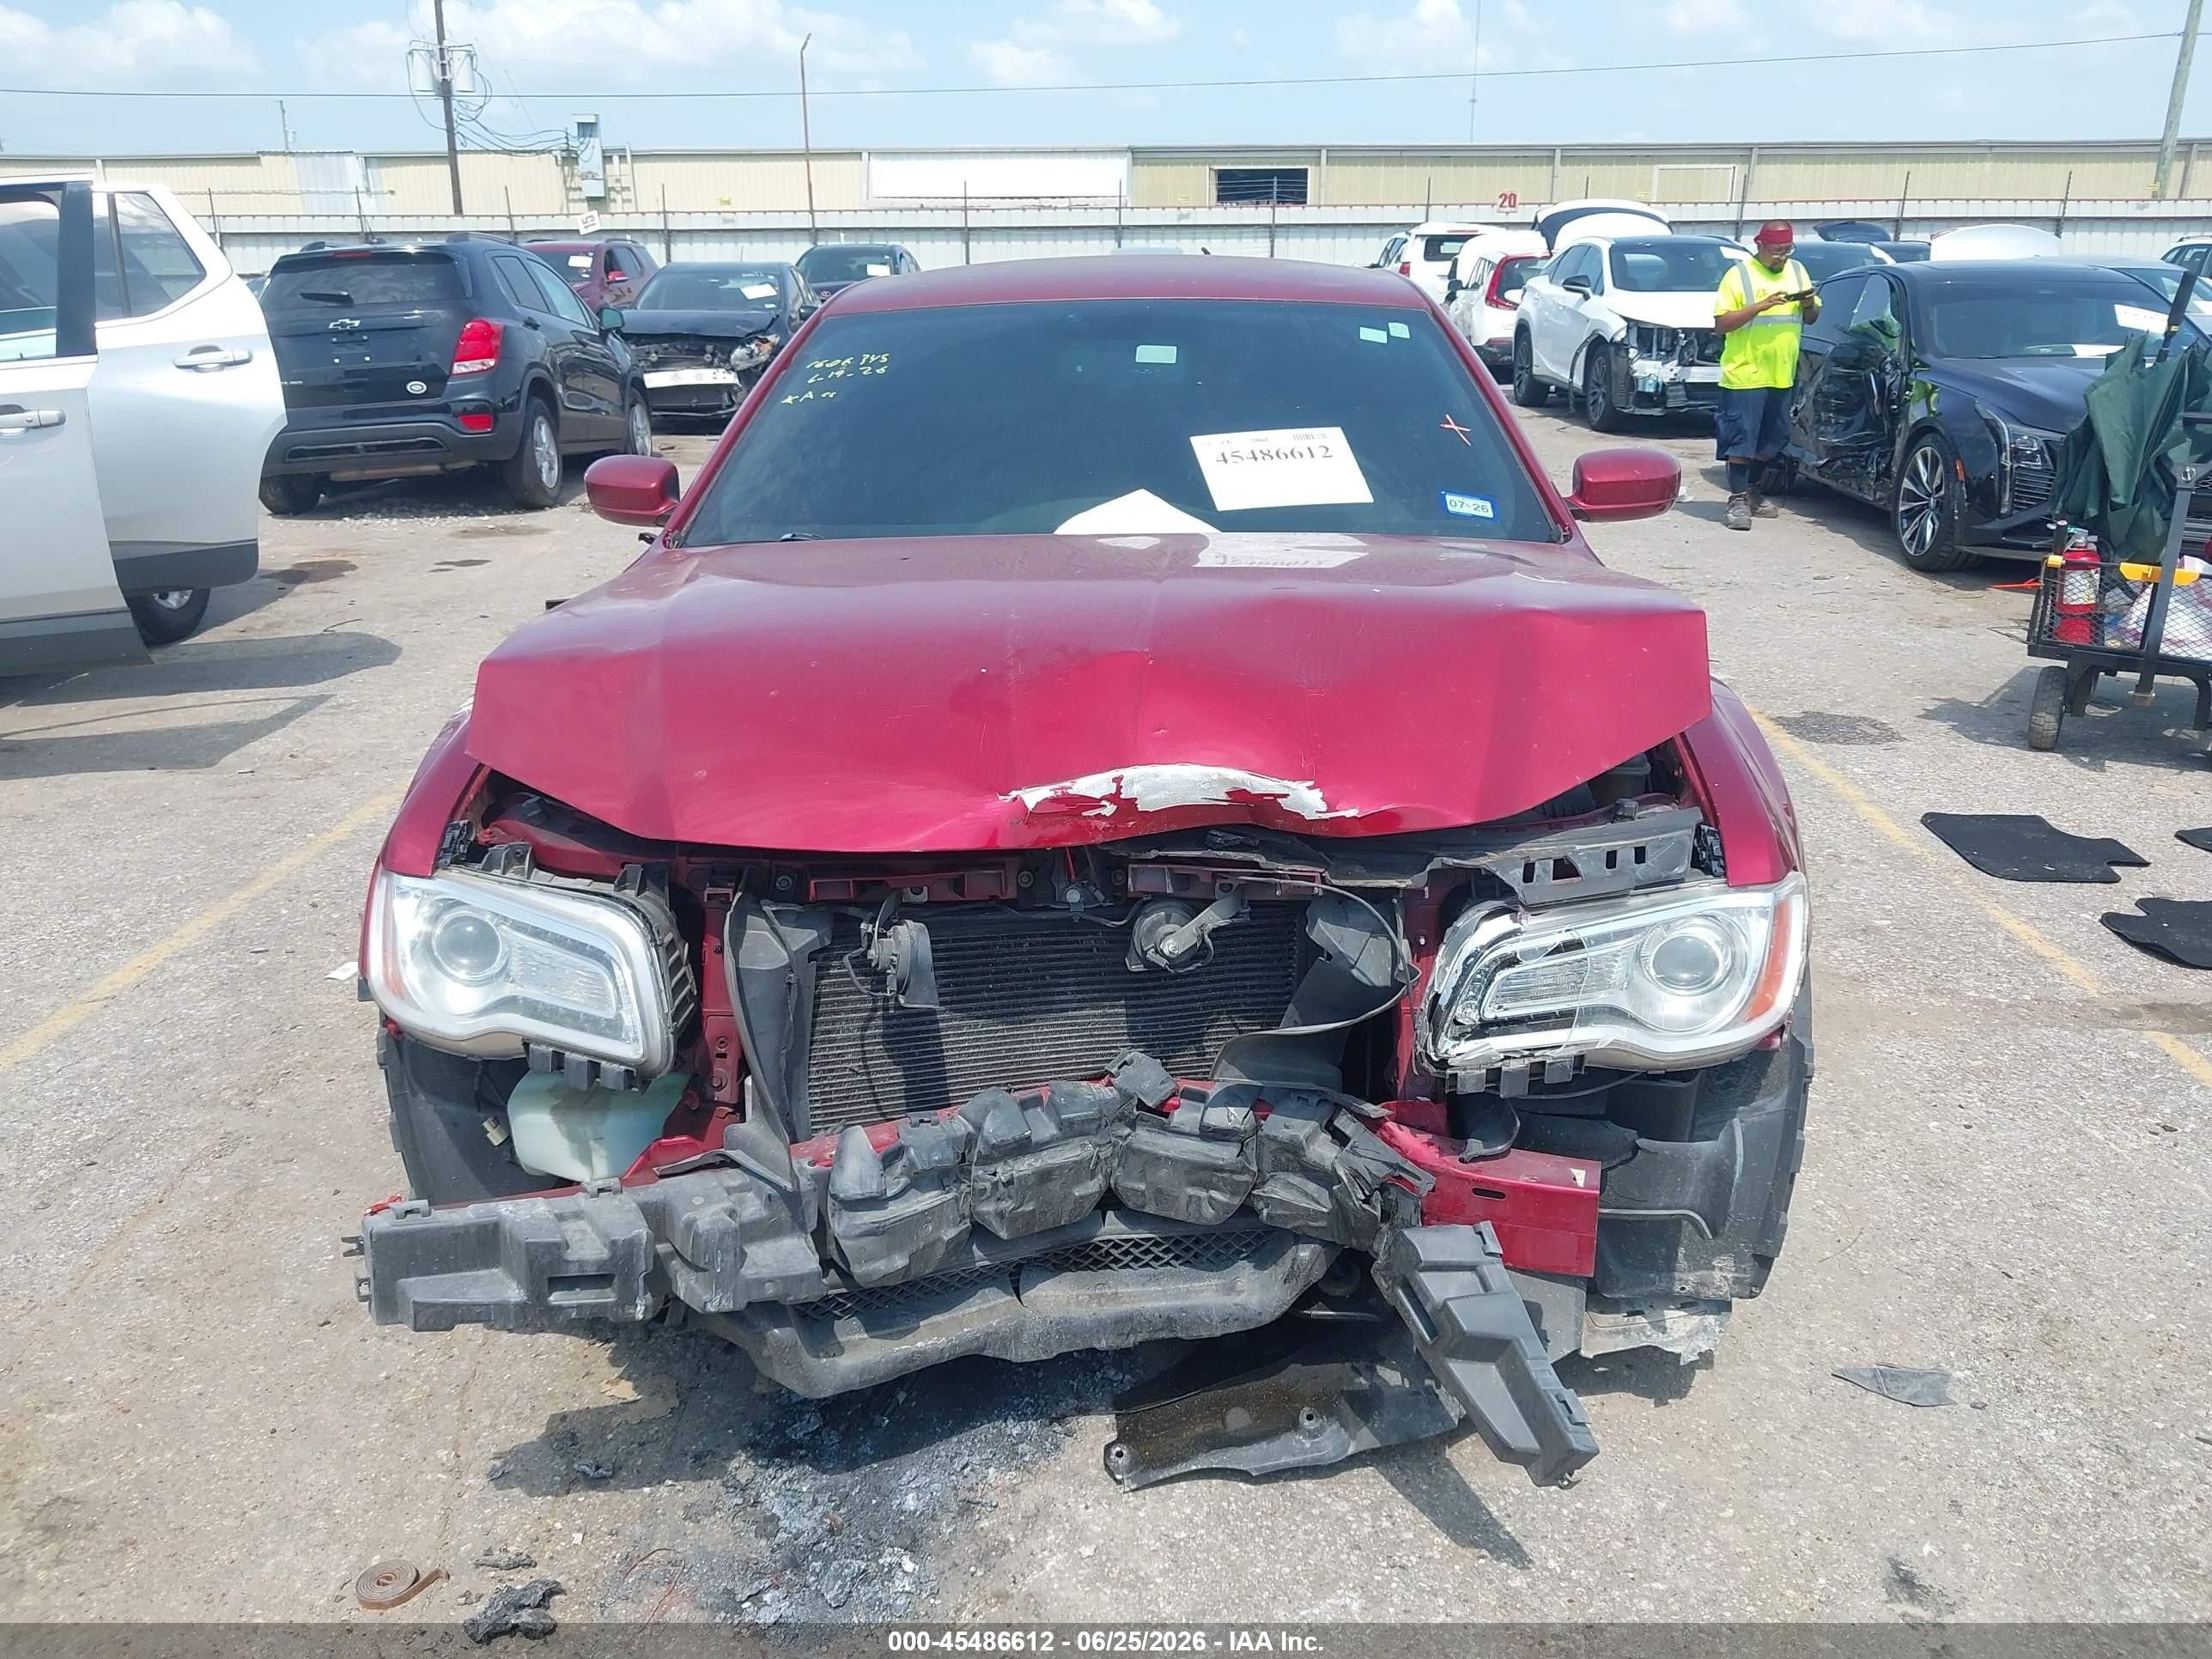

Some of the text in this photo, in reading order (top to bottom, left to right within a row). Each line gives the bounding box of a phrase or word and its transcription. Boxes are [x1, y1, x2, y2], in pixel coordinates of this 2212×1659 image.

[1498, 192, 1517, 208] 20
[581, 215, 597, 230] 15
[1216, 445, 1334, 465] 45486612
[1449, 499, 1489, 514] 07-26
